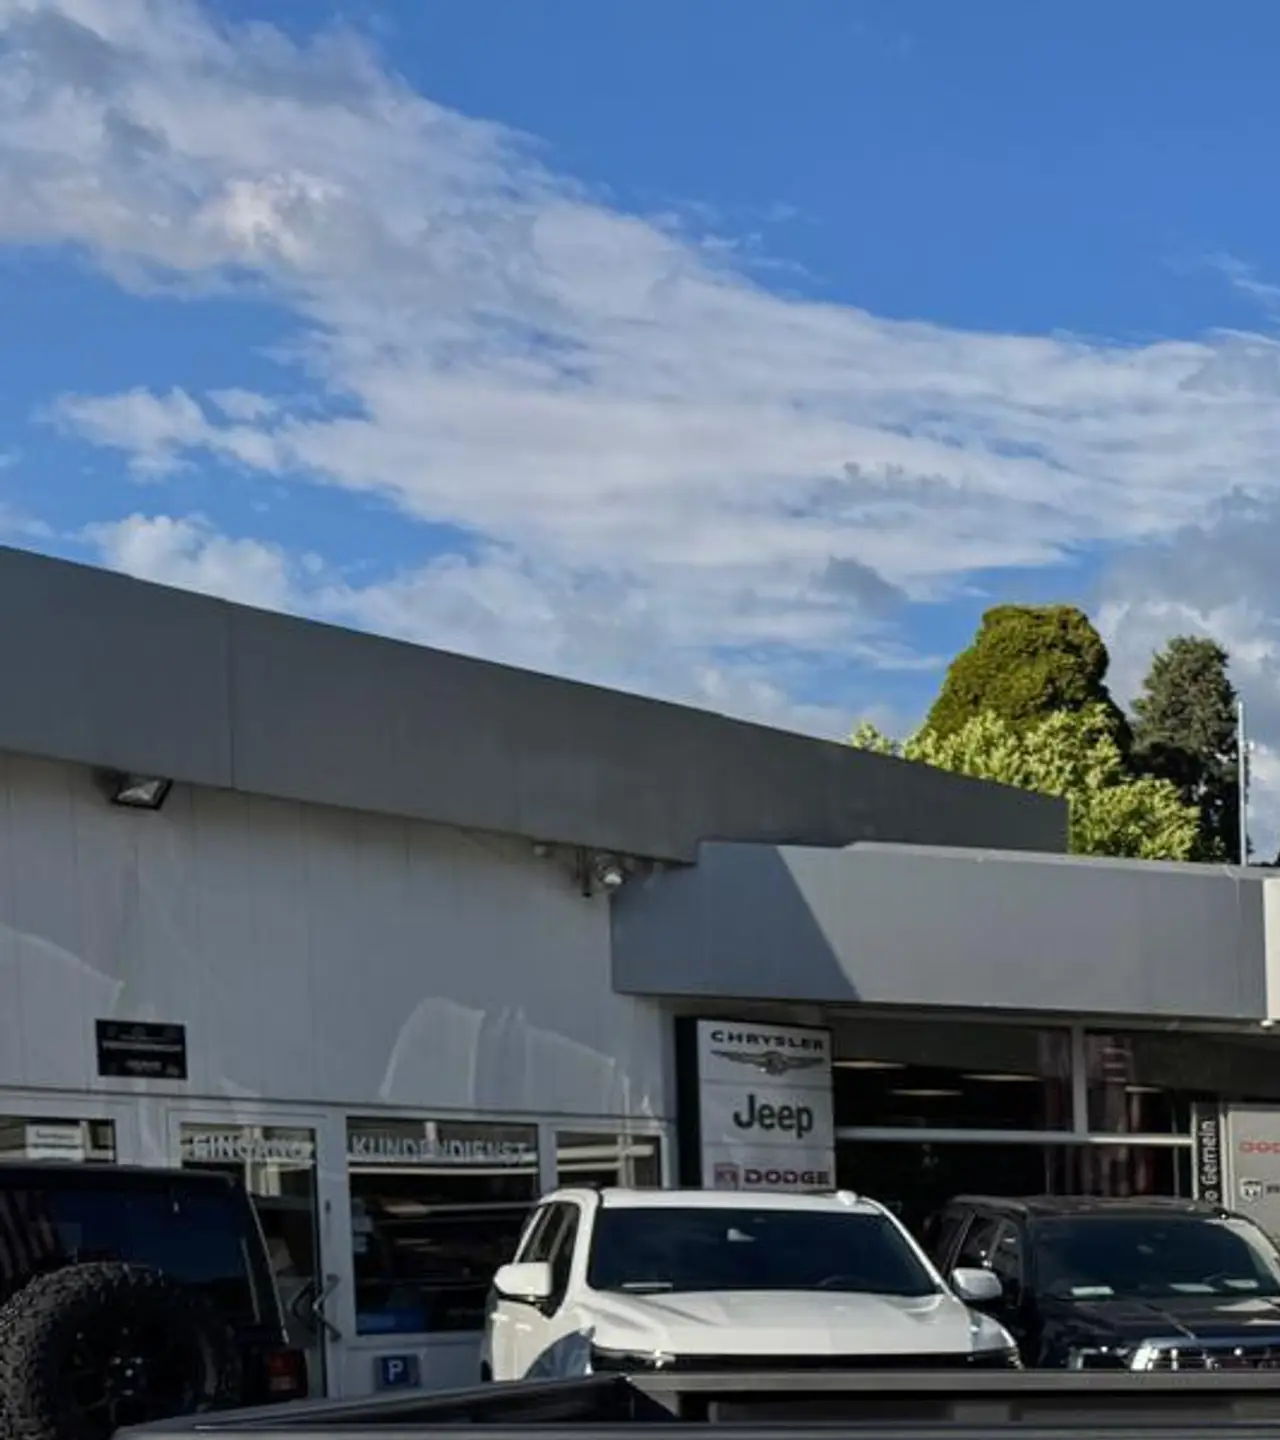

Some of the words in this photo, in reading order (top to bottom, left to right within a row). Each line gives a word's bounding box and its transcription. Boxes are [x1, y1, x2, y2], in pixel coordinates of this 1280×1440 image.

[710, 1029, 824, 1050] CHRYSLER
[732, 1094, 814, 1139] Jeep
[743, 1168, 830, 1186] DODGE
[388, 1359, 405, 1382] P
